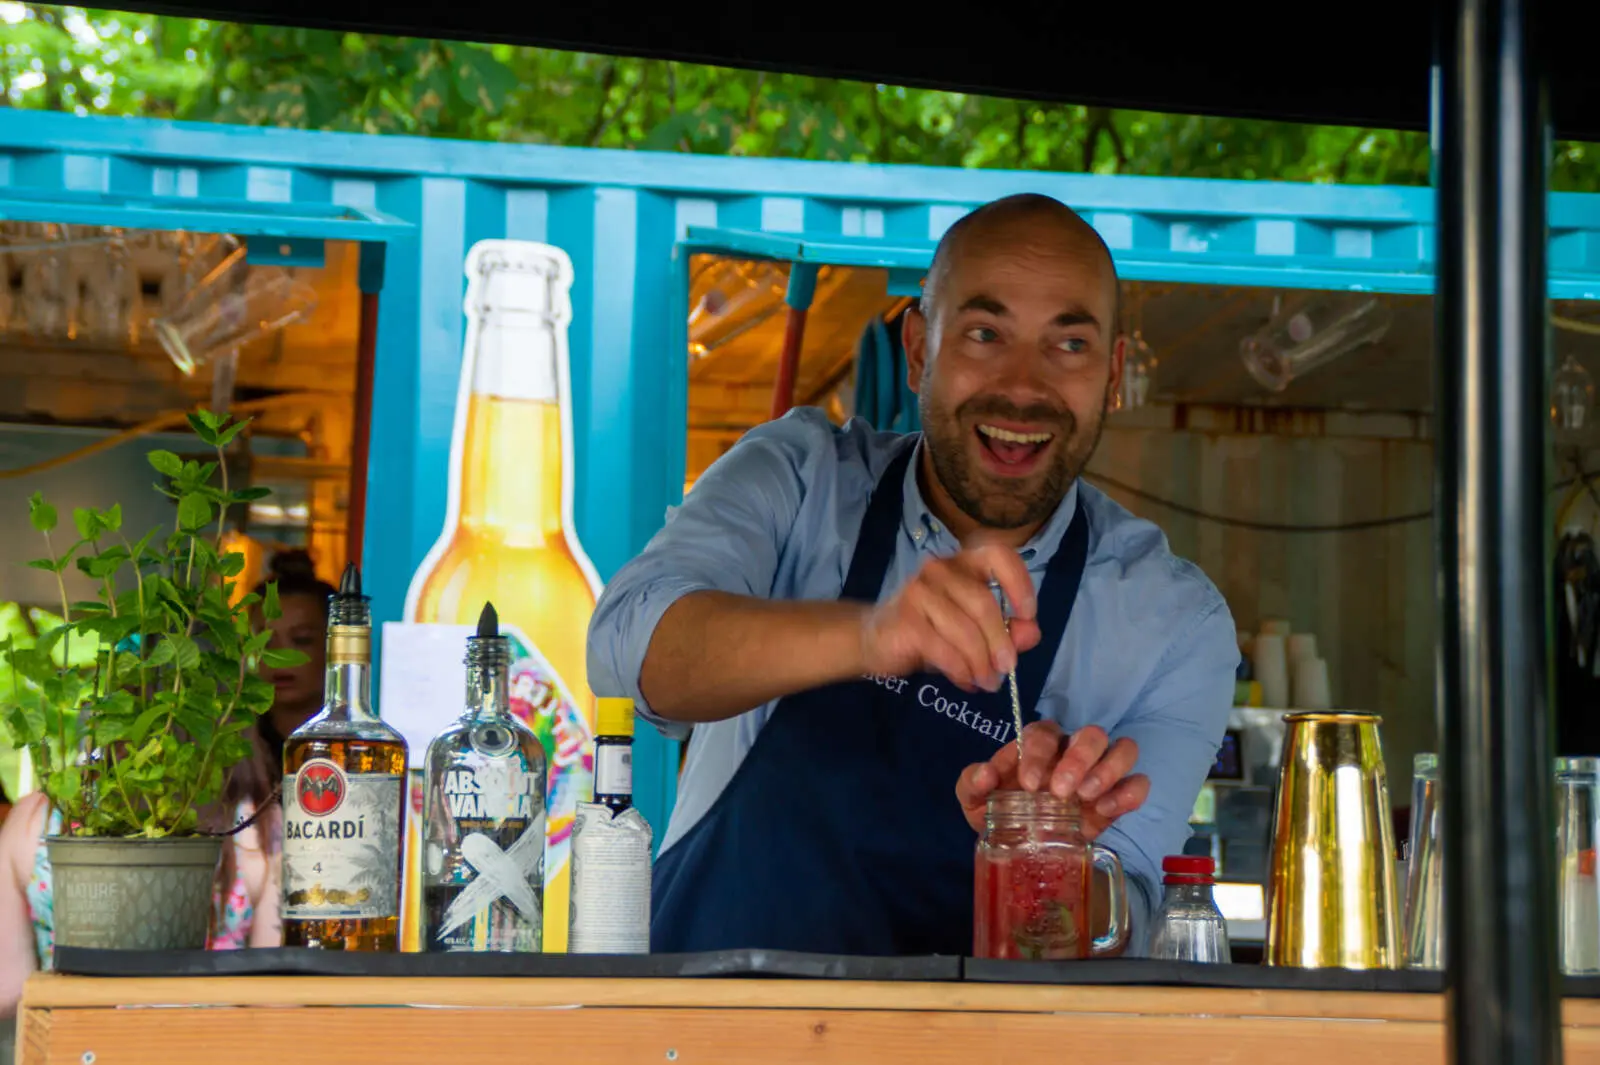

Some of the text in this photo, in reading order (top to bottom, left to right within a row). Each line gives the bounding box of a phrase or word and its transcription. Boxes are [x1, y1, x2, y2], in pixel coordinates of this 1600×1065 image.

[917, 683, 1011, 744] Cocktail
[444, 769, 539, 795] ABST
[449, 793, 532, 818] VANA
[286, 814, 365, 839] BACARDÍ
[312, 861, 323, 874] 4
